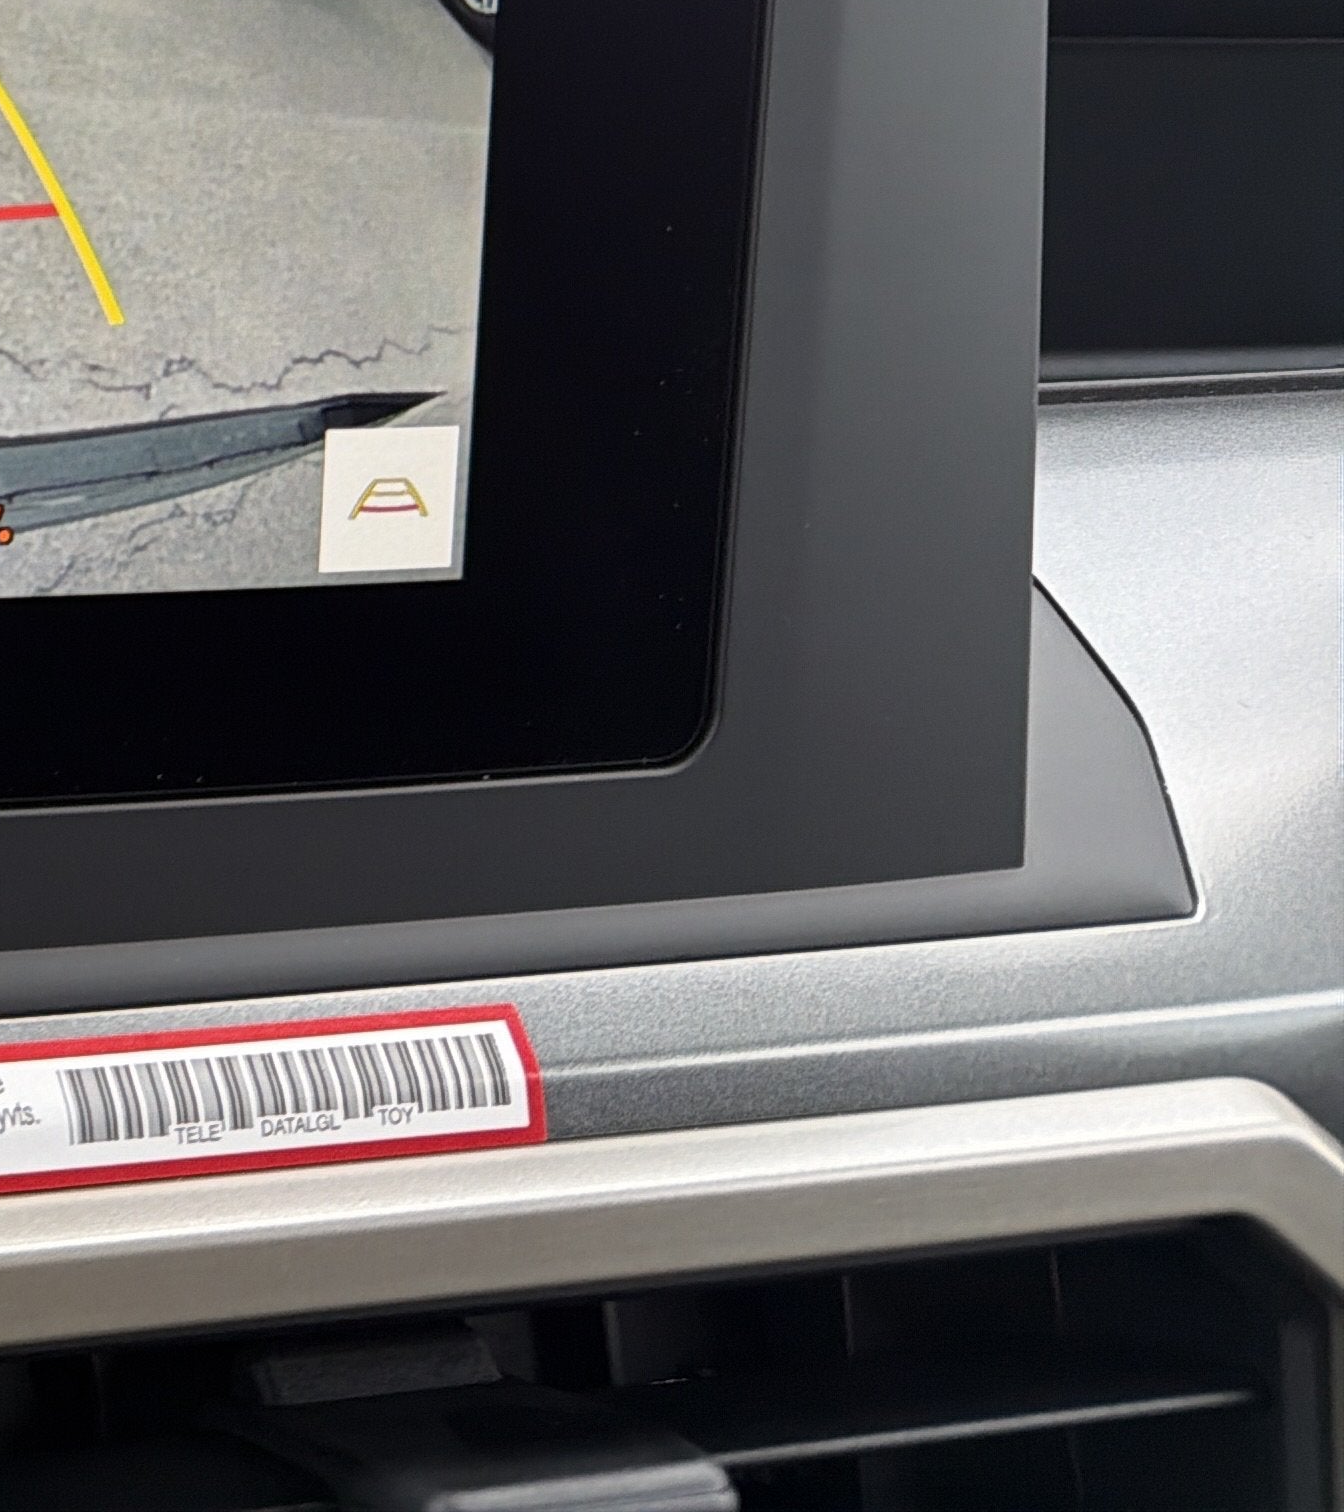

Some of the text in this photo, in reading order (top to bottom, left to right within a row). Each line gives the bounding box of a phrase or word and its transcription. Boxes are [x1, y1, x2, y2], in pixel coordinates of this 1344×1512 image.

[173, 1105, 414, 1145] TELE DATALGL TOY
